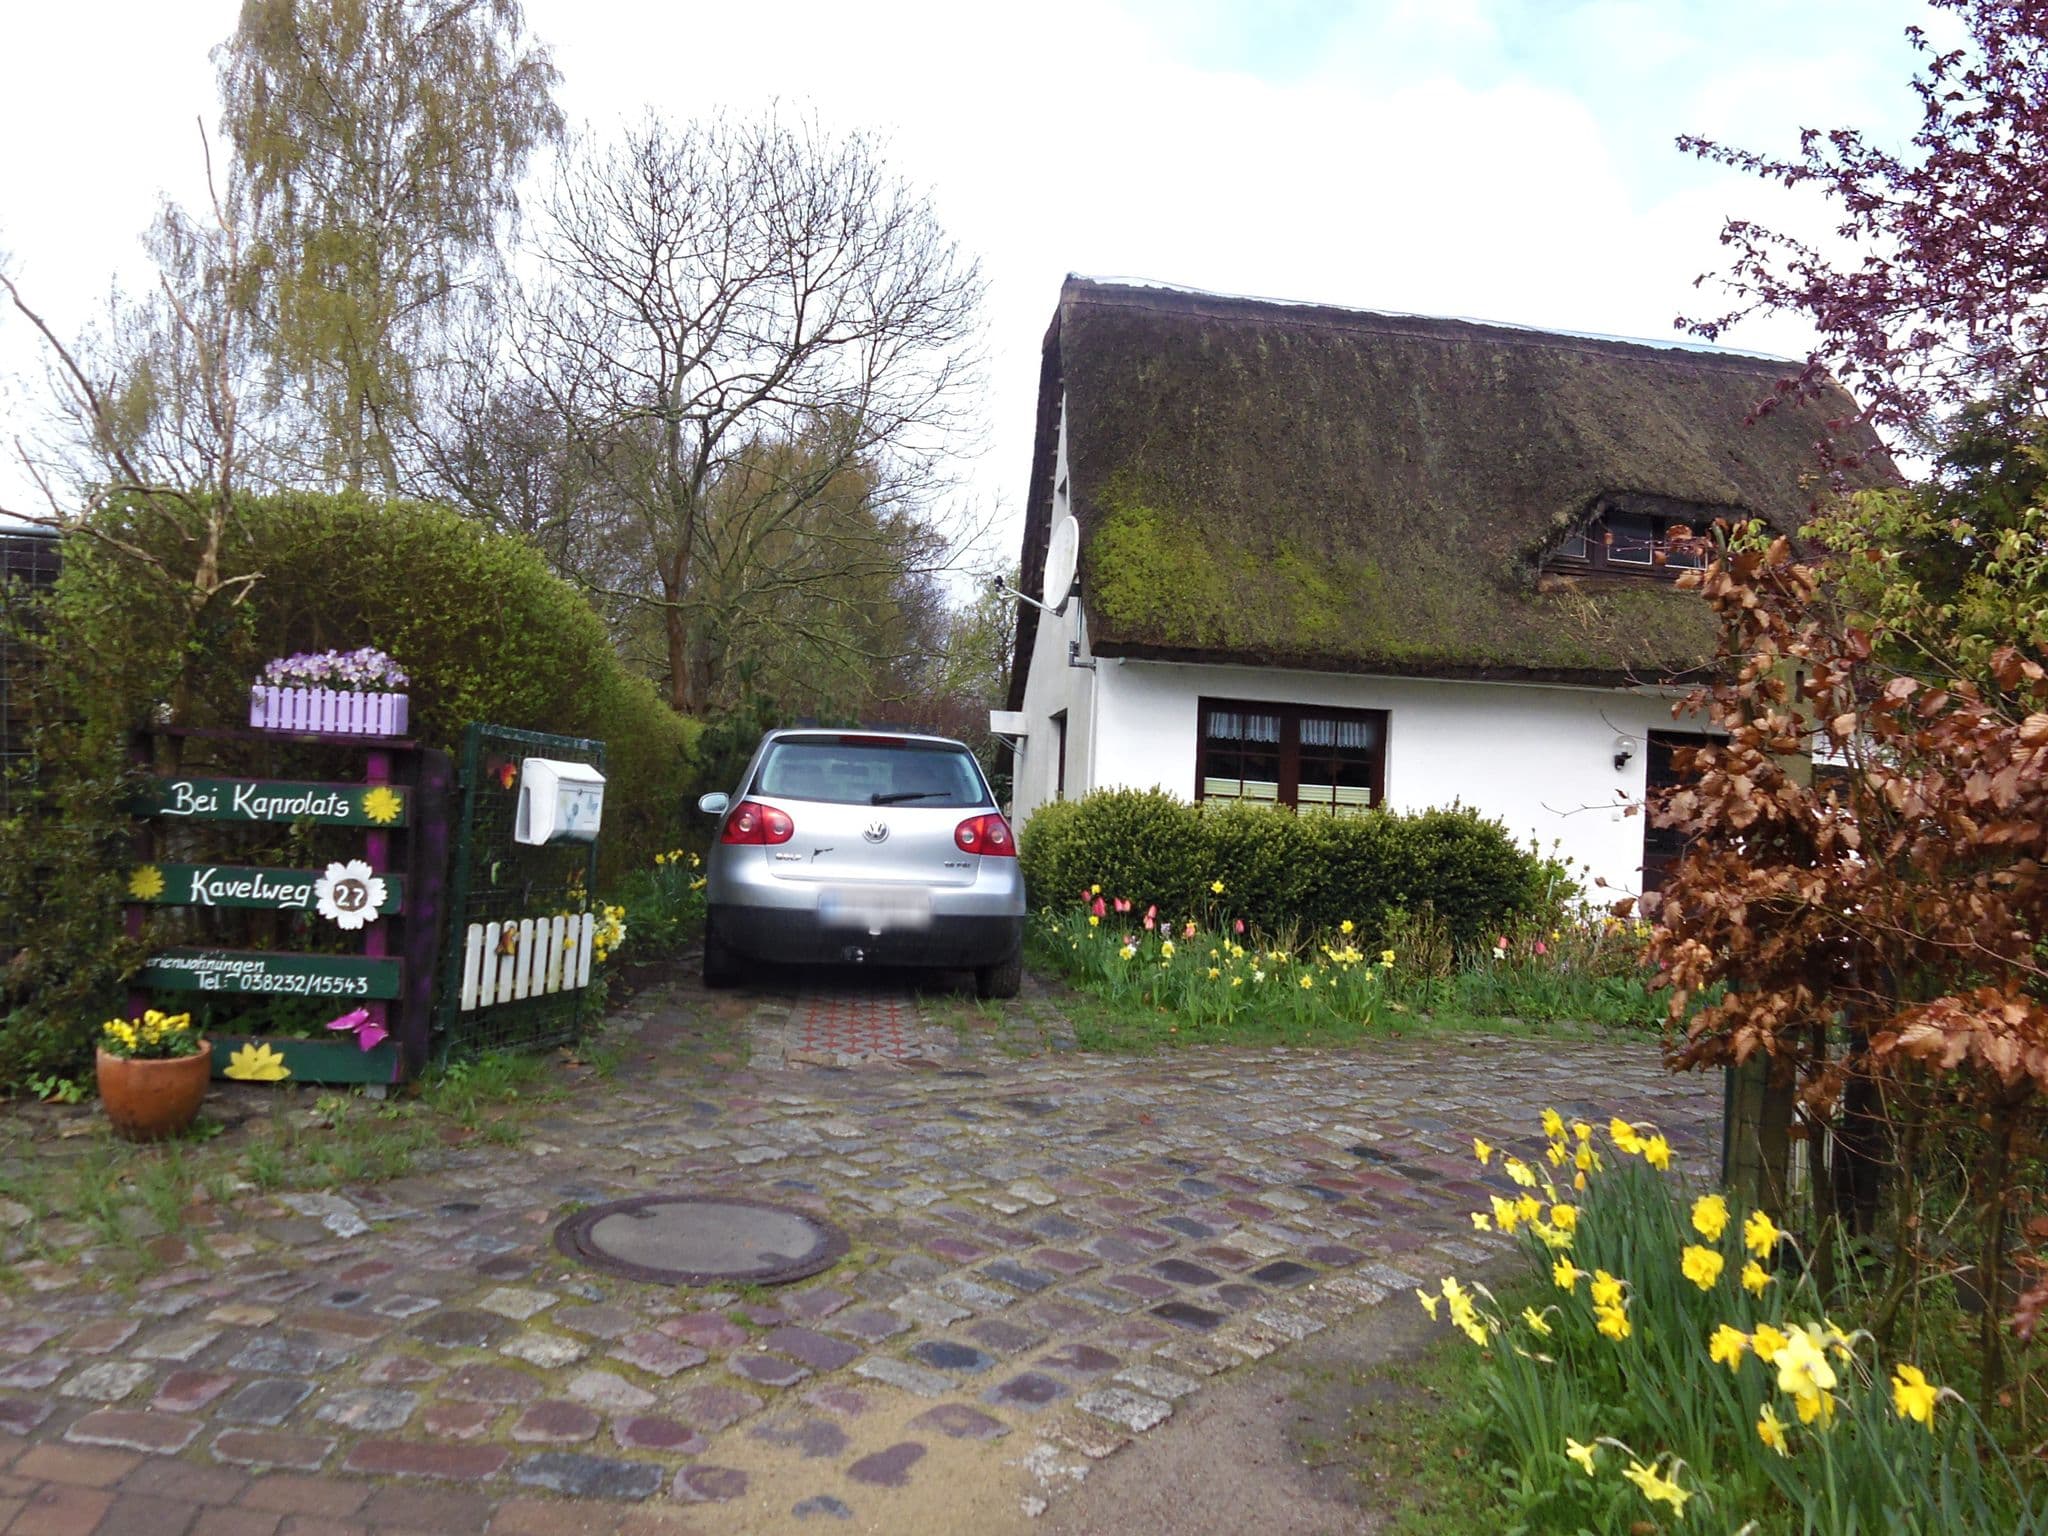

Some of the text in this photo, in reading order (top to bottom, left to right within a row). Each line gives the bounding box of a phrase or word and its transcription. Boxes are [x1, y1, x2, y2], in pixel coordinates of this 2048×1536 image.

[160, 782, 349, 820] Bei Kaprolats
[190, 868, 312, 909] Kavelweg
[335, 885, 364, 907] 27
[145, 952, 265, 977] erienwohnungen
[240, 974, 368, 995] 038232/15543
